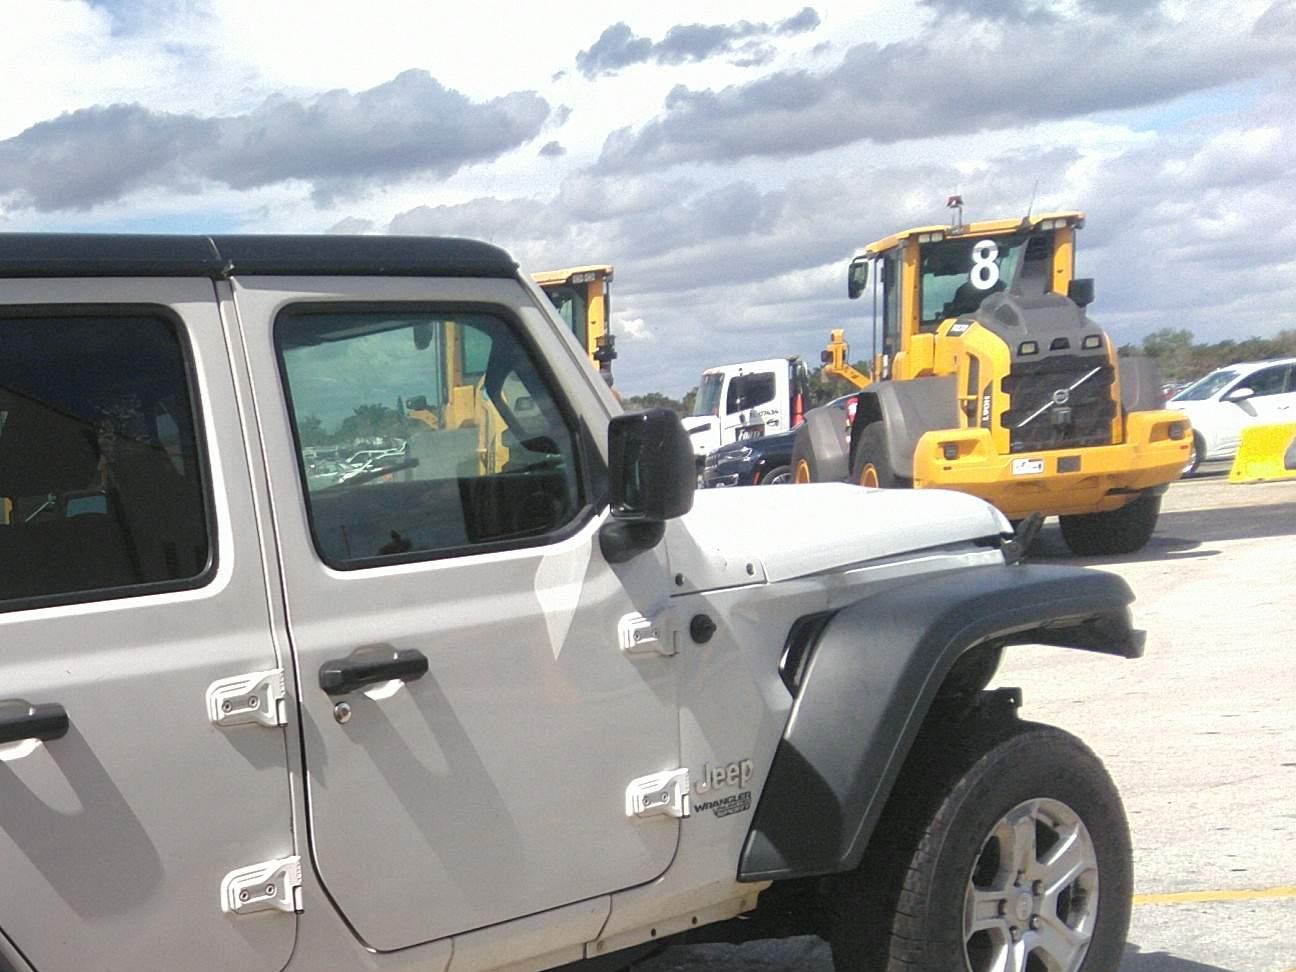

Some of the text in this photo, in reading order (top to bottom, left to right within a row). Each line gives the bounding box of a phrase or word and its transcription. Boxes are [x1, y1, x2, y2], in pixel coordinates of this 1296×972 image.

[970, 239, 1000, 290] 8
[695, 760, 753, 794] Jeep
[694, 791, 752, 813] WRANGLER
